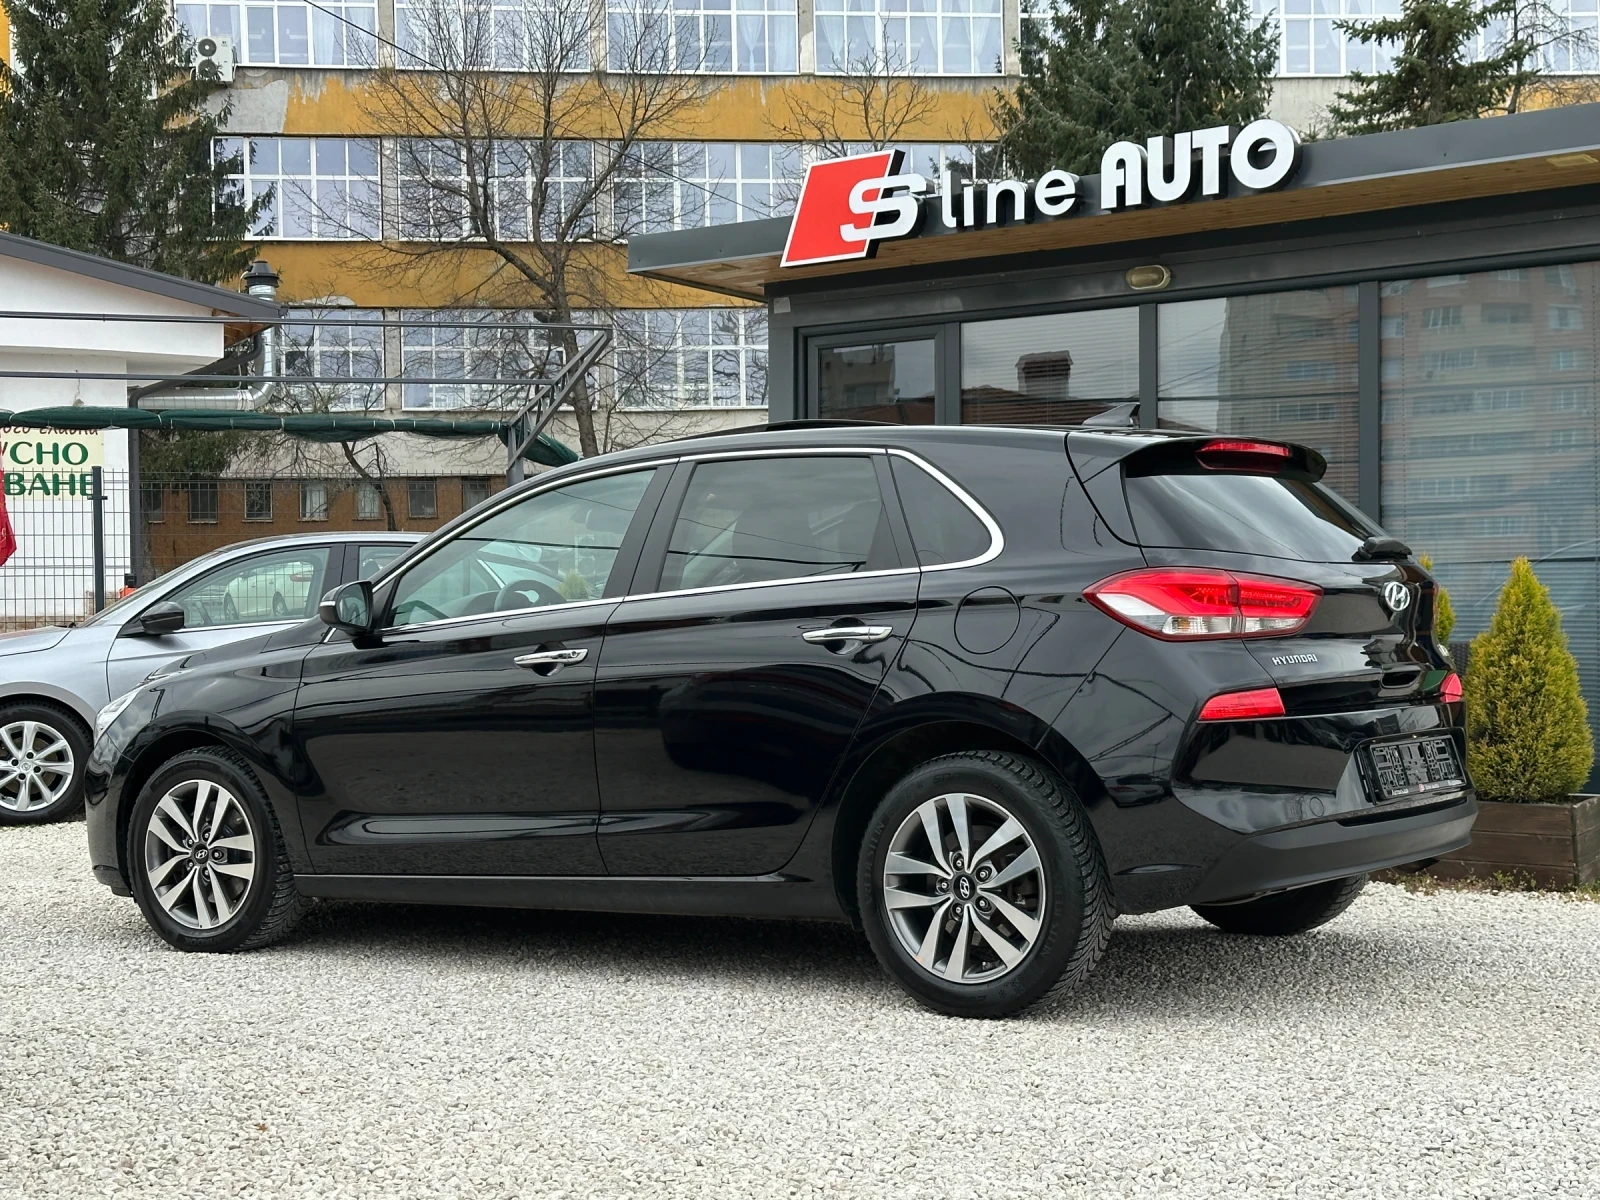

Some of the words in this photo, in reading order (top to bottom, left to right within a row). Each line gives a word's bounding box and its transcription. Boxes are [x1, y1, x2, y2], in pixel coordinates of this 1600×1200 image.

[941, 169, 1078, 228] line
[1100, 118, 1294, 210] AUTO
[1271, 653, 1318, 666] HYUNDAI
